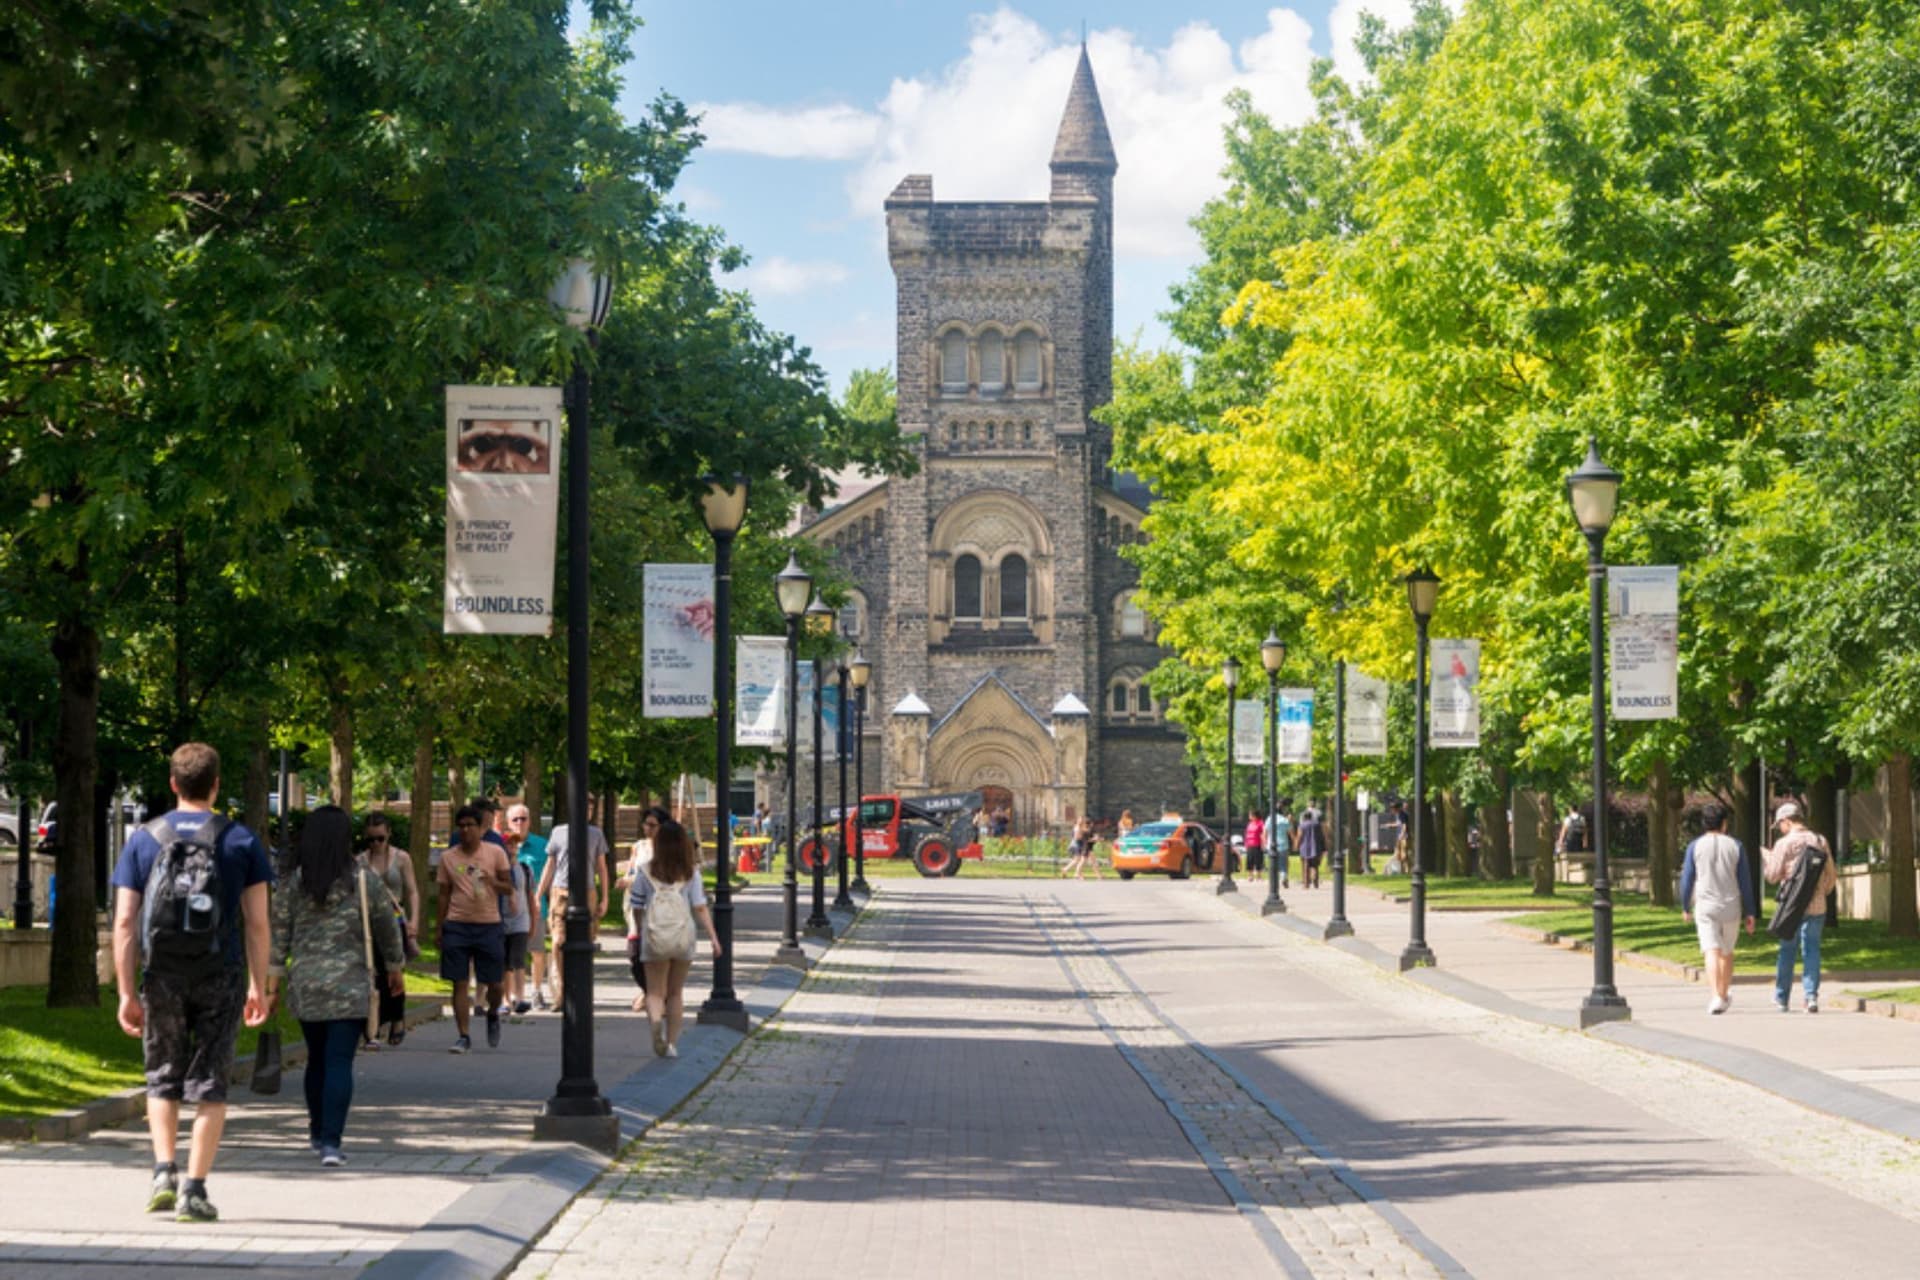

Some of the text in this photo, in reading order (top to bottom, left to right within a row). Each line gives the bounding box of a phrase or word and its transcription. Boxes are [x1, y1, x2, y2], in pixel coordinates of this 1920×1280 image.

[468, 520, 511, 530] PRIVACY
[466, 531, 498, 541] THING
[500, 531, 514, 541] OF
[456, 542, 509, 552] THE PAST?
[455, 595, 544, 615] BOUNDLESS
[650, 694, 707, 706] BOUNDLESS
[1617, 695, 1672, 707] BOUNDLESS
